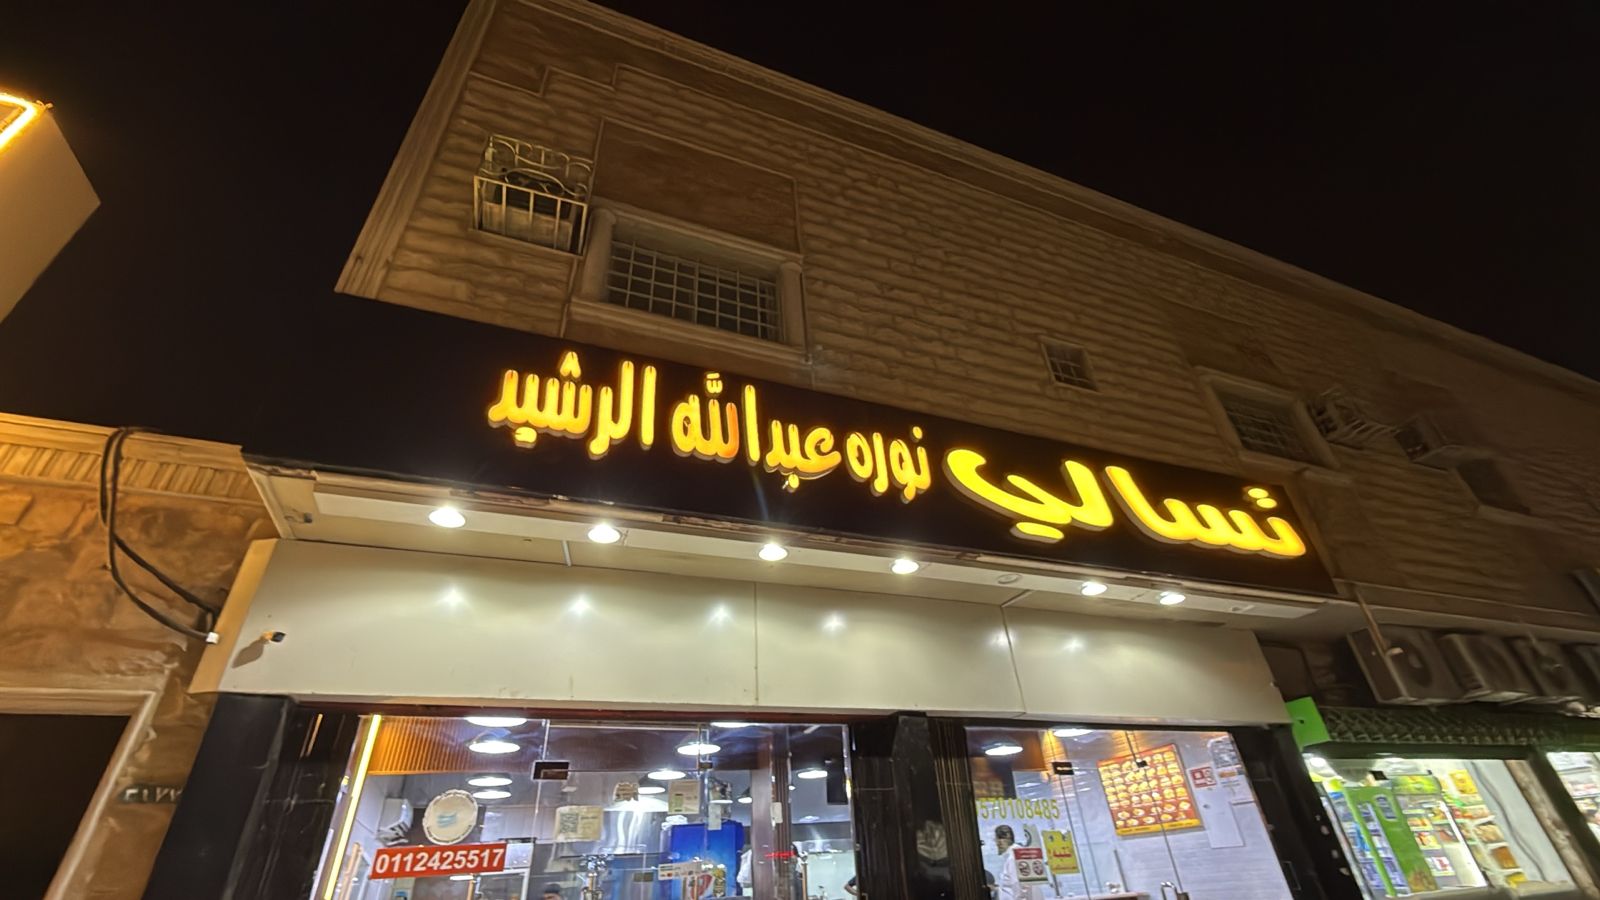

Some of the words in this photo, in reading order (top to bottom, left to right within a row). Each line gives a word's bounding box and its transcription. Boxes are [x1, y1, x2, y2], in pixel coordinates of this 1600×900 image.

[487, 350, 658, 459] الرشيد
[846, 426, 932, 502] نوره
[945, 448, 1306, 558] تسالي
[375, 848, 505, 875] 0112425517
